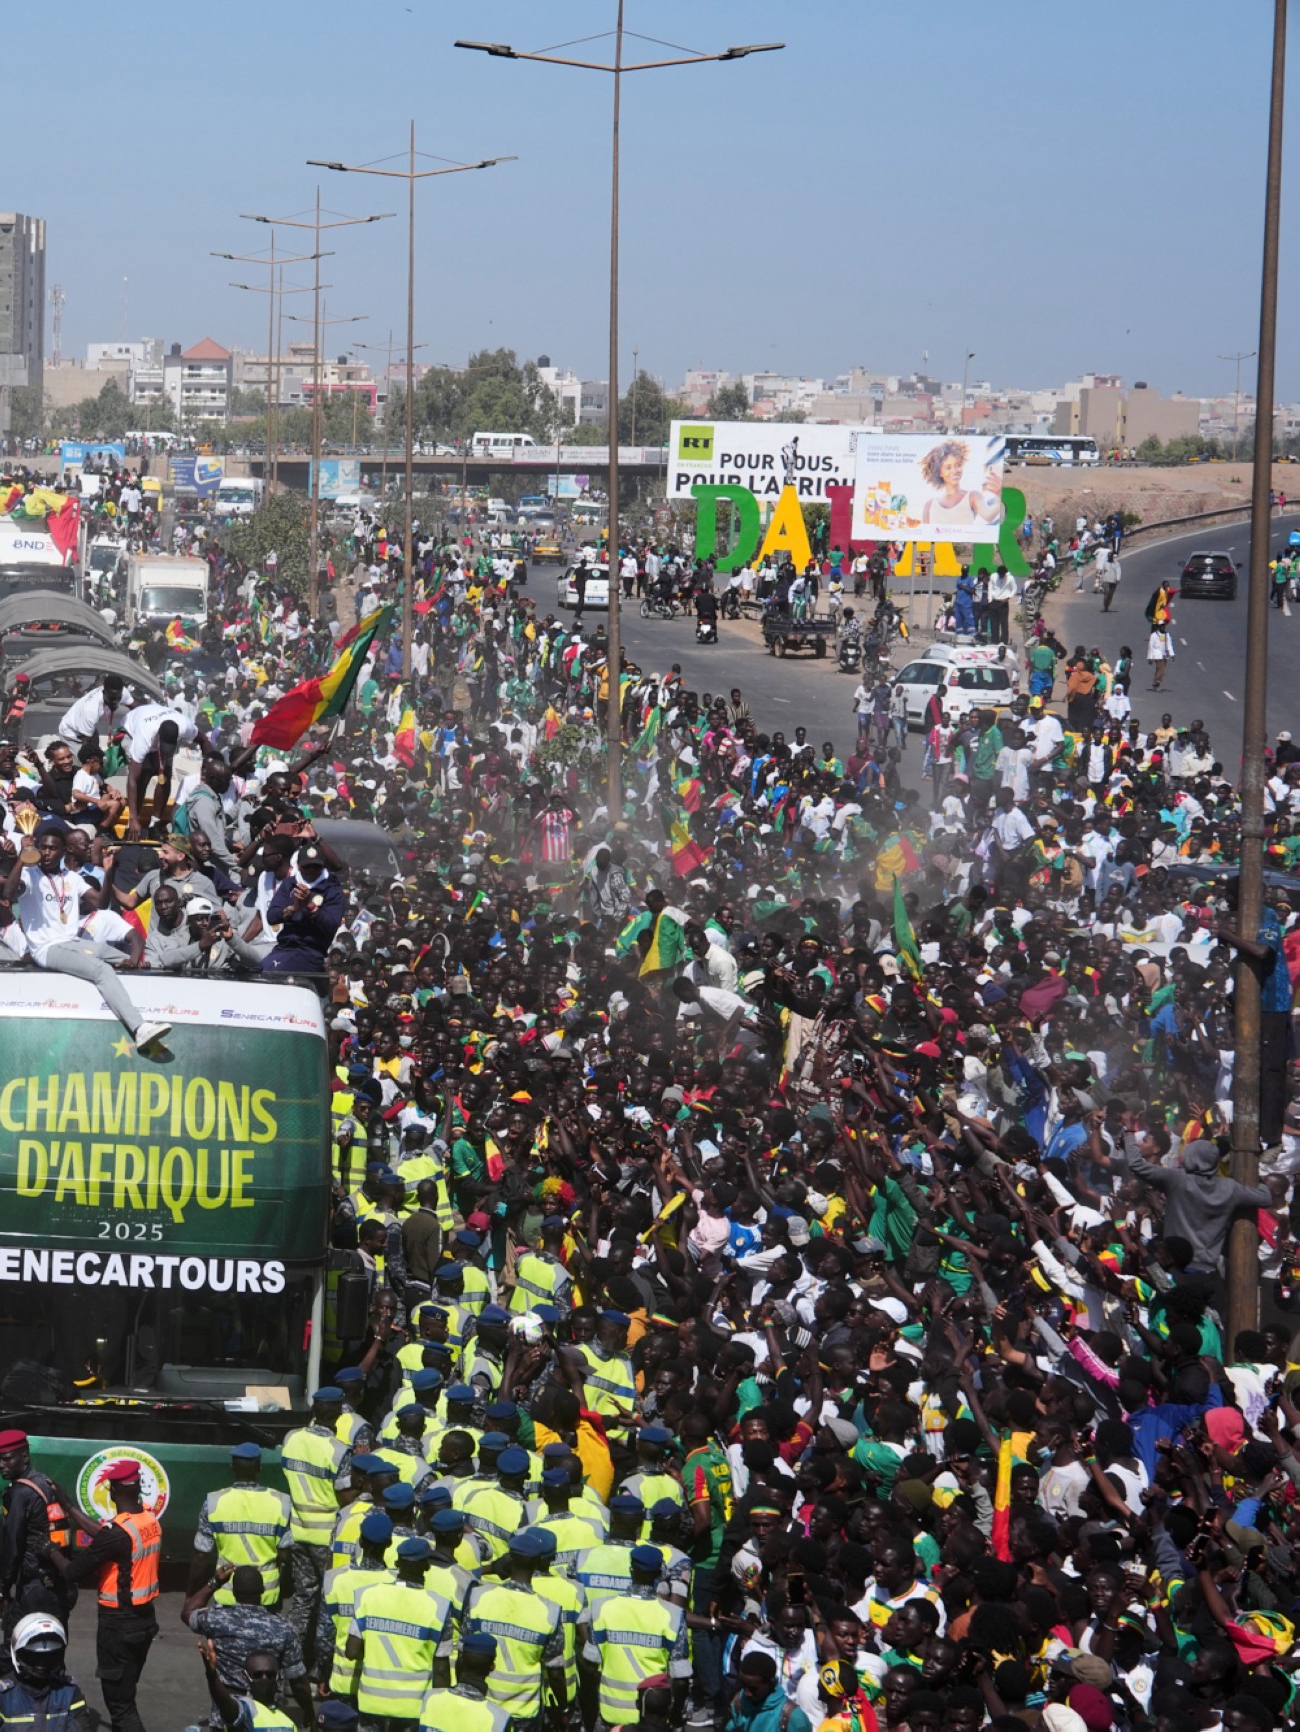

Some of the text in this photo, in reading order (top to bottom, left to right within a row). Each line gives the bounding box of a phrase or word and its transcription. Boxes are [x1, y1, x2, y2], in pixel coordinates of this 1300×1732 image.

[683, 437, 713, 449] RT
[720, 453, 775, 470] POUR
[45, 893, 73, 902] Orge
[100, 1001, 200, 1016] SCARTOURS
[16, 1139, 255, 1224] D'AFRIQUE
[97, 1221, 165, 1241] 2025
[139, 1525, 160, 1541] POLICE
[224, 1522, 276, 1536] GENDARMERIE
[365, 1618, 421, 1639] GENDARMERIE
[480, 1620, 540, 1644] GENDARMERIE
[606, 1630, 663, 1649] GENDARMERI
